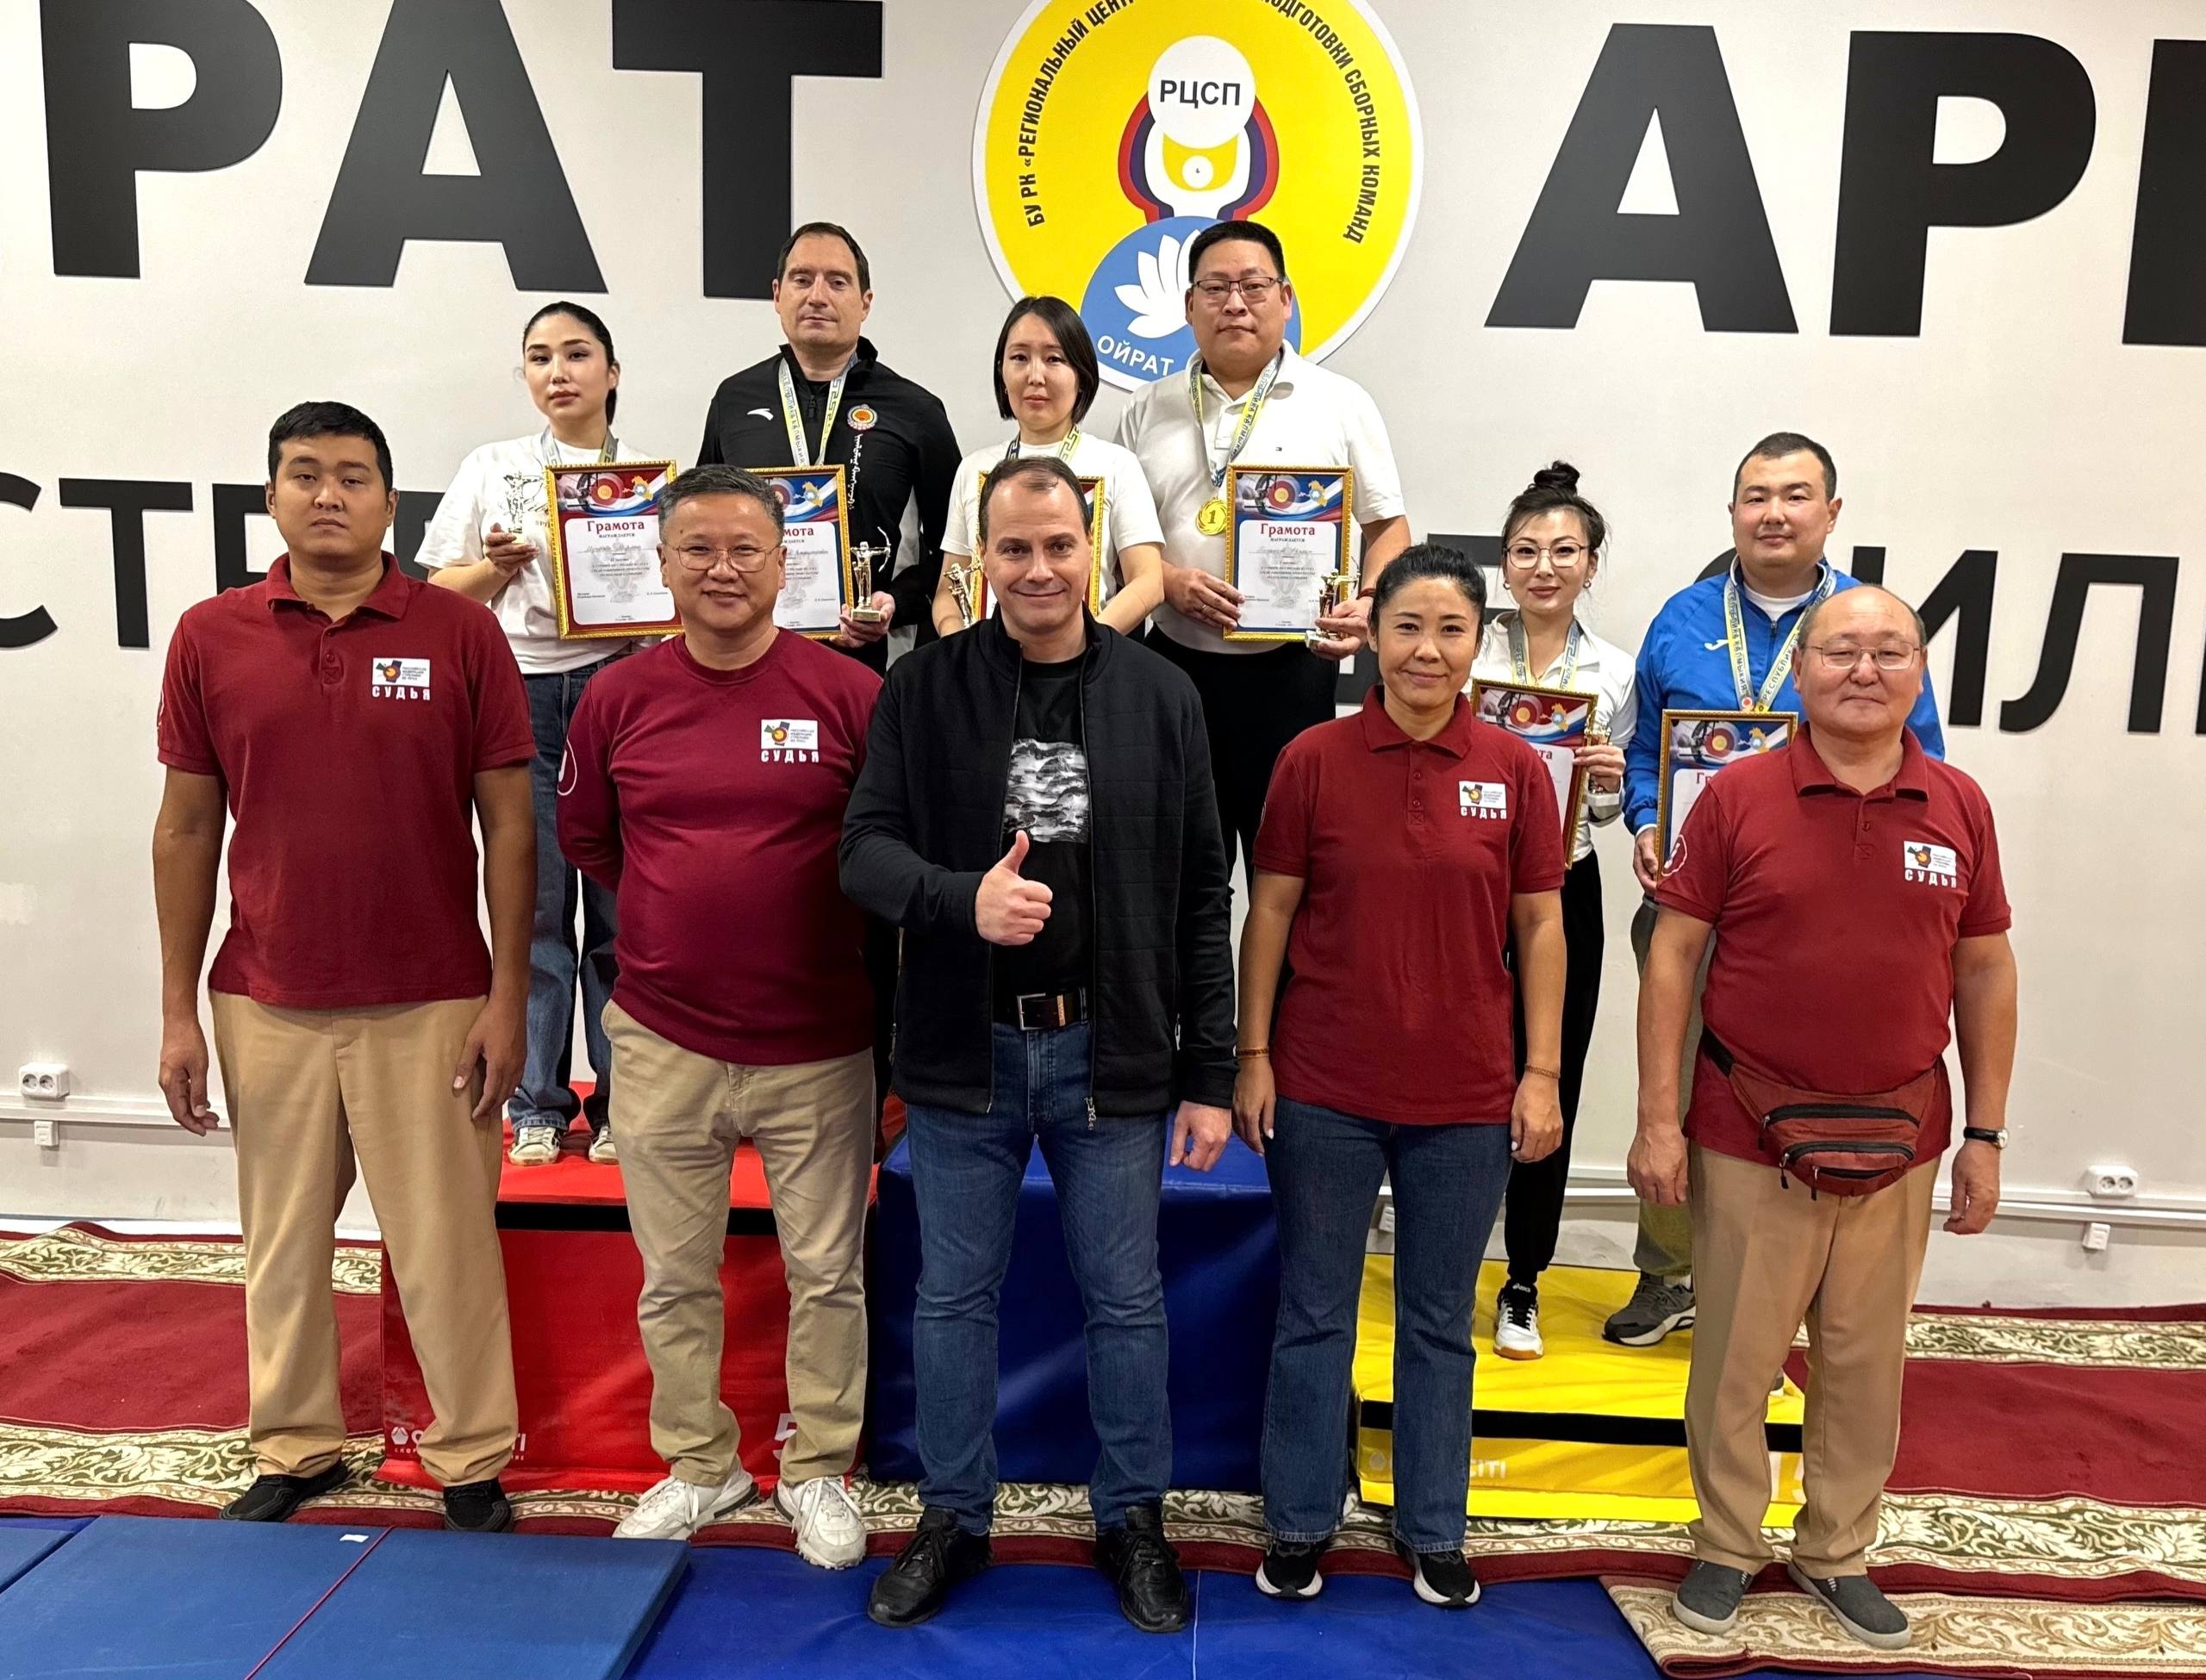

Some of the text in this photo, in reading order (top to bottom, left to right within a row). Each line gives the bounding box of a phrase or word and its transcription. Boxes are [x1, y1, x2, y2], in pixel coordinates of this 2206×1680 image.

[1085, 0, 1134, 27] ЦЕН
[1160, 79, 1241, 109] РЦСП
[1344, 68, 1380, 159] СБОРНЫХ
[1019, 173, 1038, 198] РК
[1343, 165, 1380, 244] КОМАНД
[1024, 204, 1045, 227] БУ
[1097, 335, 1175, 376] ОЙРАТ
[587, 520, 645, 534] Грамота
[1207, 510, 1216, 524] 1
[1261, 523, 1315, 538] Грамота
[372, 686, 430, 700] СУДЬЯ
[761, 750, 819, 763] СУДЬЯ
[1461, 806, 1507, 819] СУДЬЯ
[1905, 869, 1957, 889] СУДЬЯ
